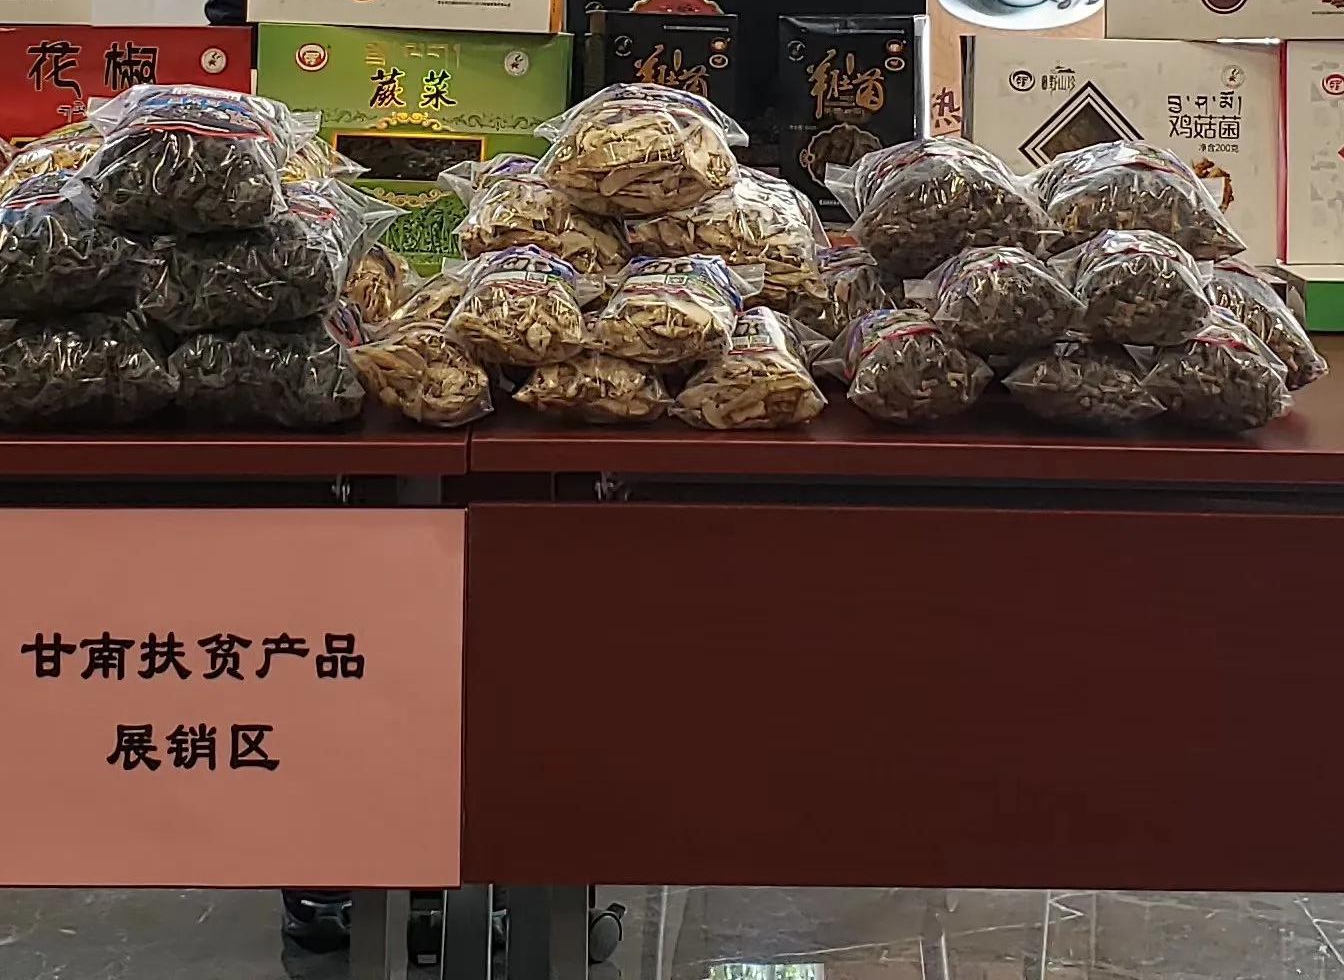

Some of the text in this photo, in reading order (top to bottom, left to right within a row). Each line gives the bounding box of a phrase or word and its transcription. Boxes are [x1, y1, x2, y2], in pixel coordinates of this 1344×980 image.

[26, 40, 159, 99] 花椒
[369, 66, 458, 112] 蕨菜
[1168, 114, 1242, 140] 鸡菇菌
[21, 630, 366, 681] 甘南扶贫产品
[106, 722, 280, 772] 展销区
